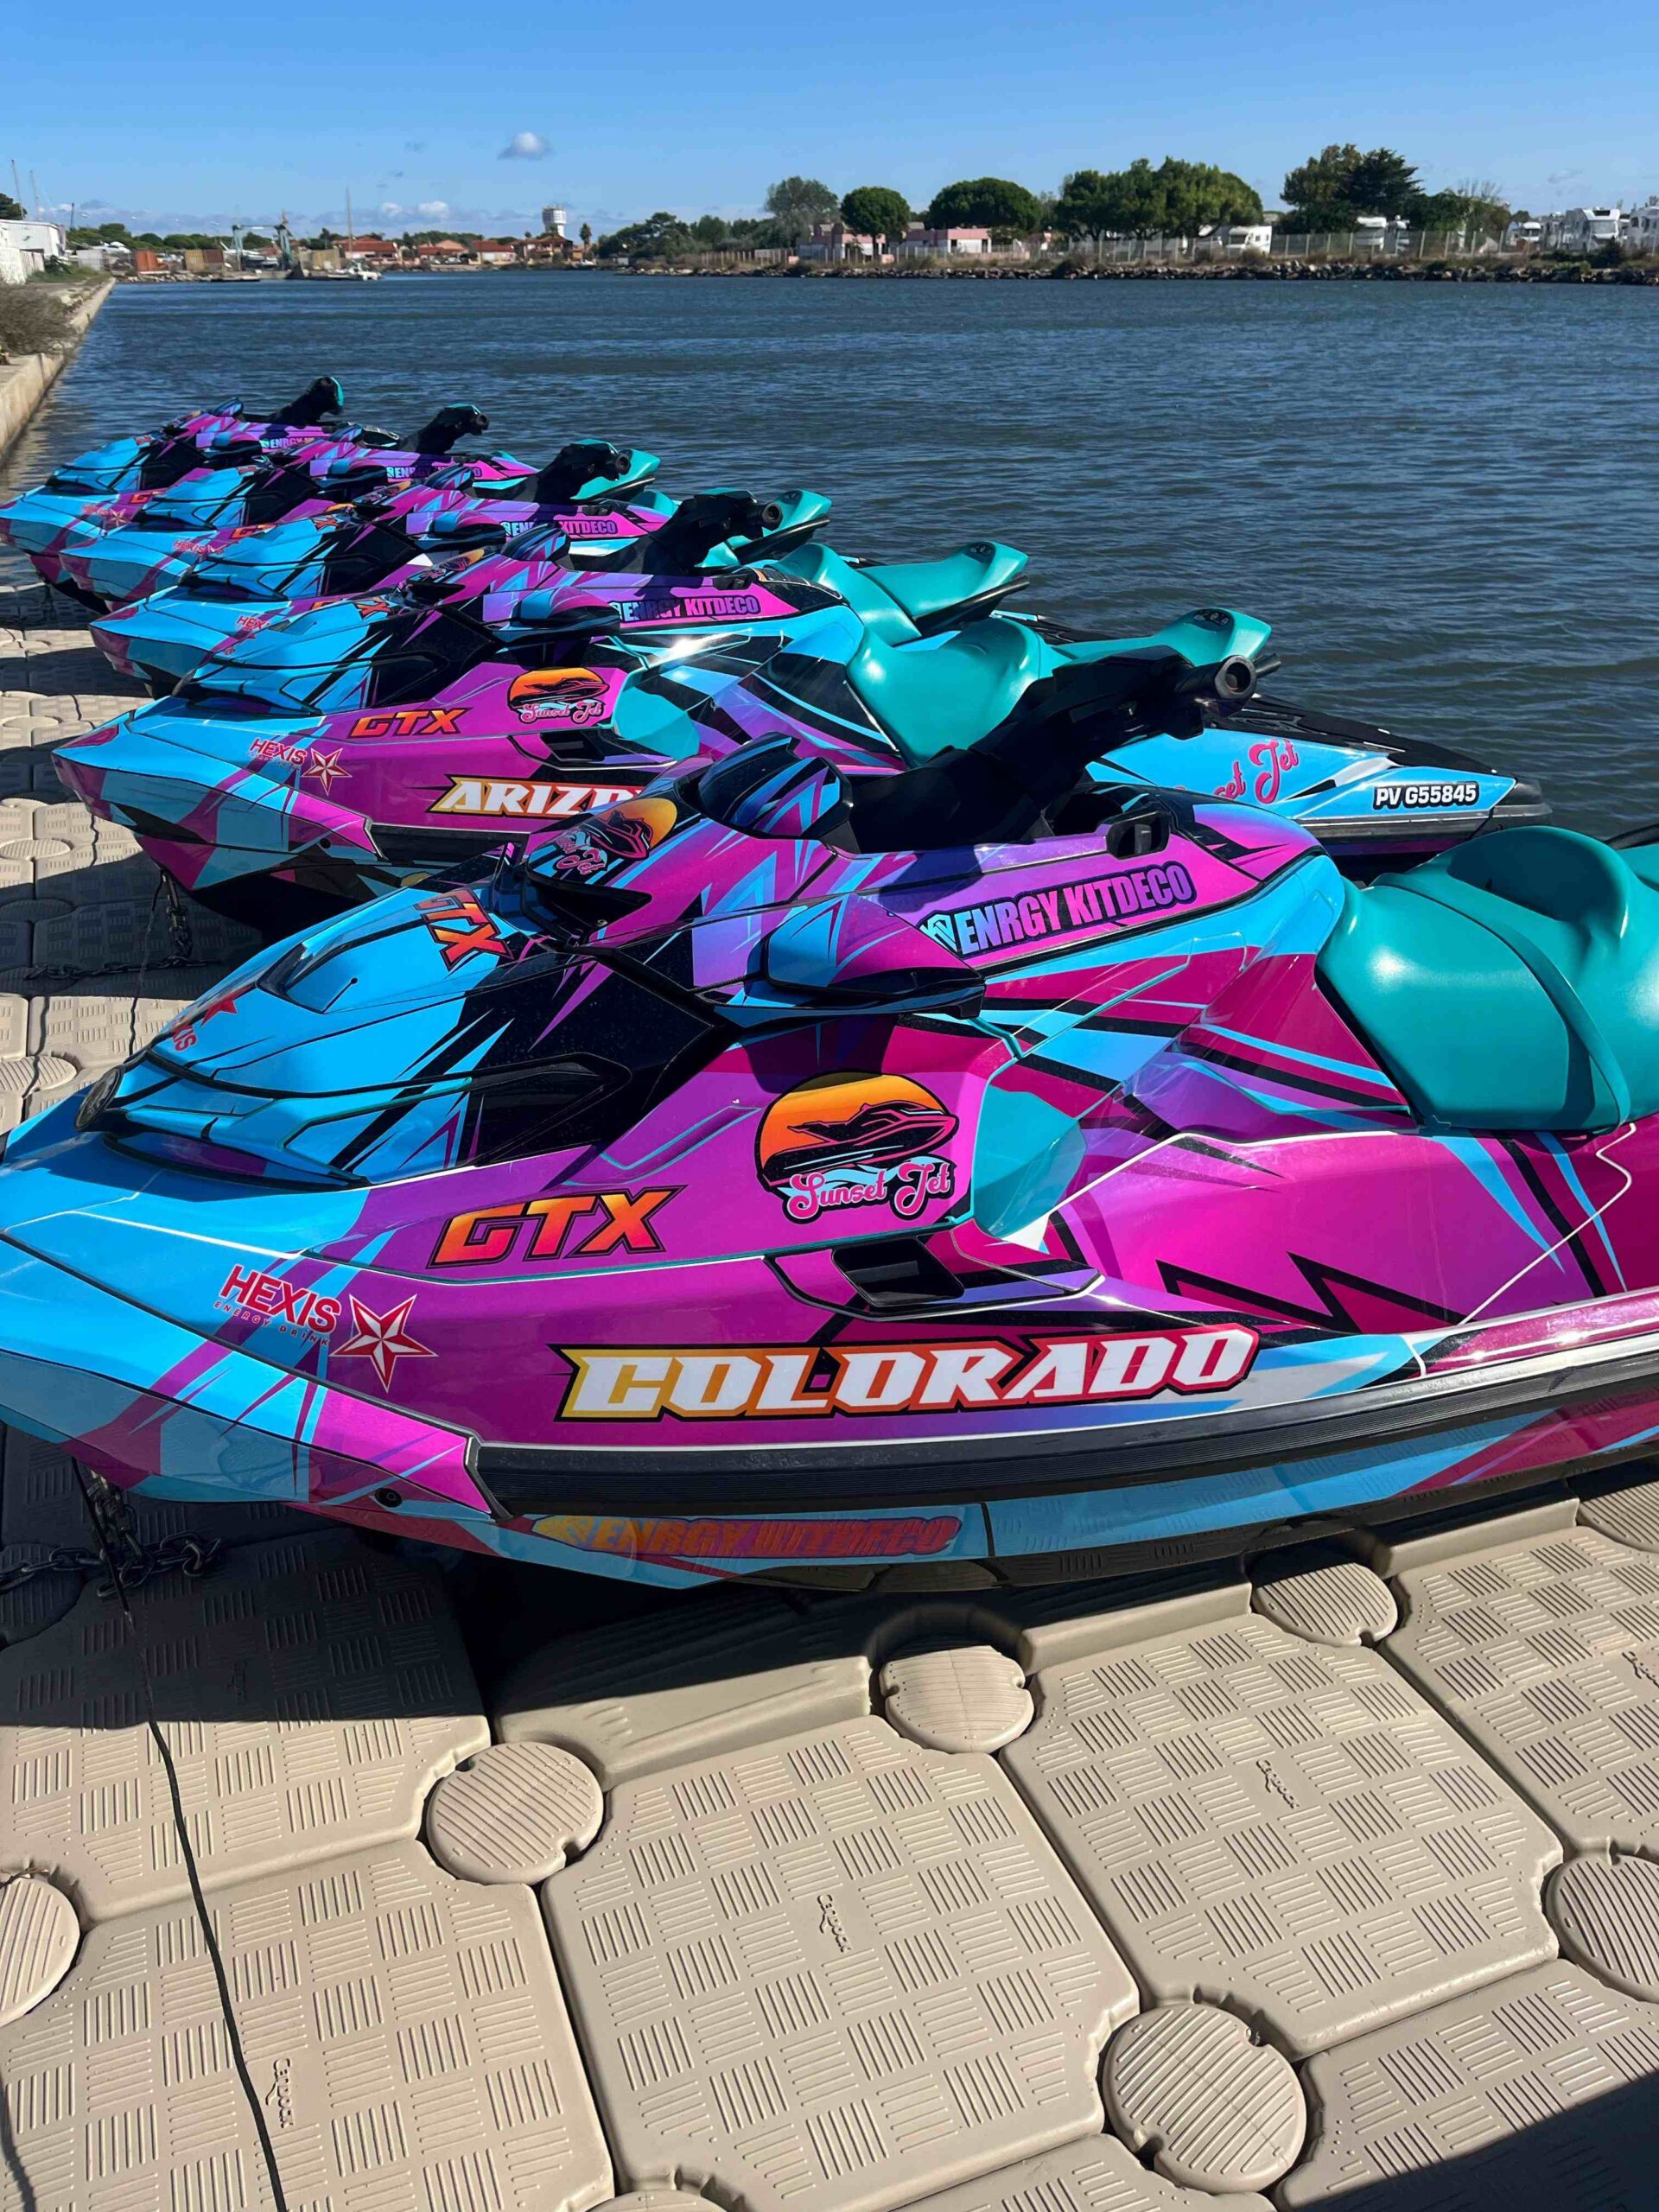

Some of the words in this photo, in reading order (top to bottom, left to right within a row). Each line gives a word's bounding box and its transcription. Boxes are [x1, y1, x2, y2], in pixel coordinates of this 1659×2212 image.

[236, 615, 270, 629] HEX
[684, 596, 760, 616] KITDECO
[347, 708, 471, 739] GTX
[520, 703, 570, 722] Sunset
[572, 701, 602, 722] Jet
[250, 738, 307, 765] HEXIS
[1249, 739, 1299, 804] Jet
[1376, 787, 1402, 806] PV
[1405, 785, 1477, 804] G55845
[954, 891, 1061, 955] ENRGY
[1063, 865, 1193, 926] KITDECO
[787, 1170, 887, 1219] Sunset
[894, 1162, 950, 1215] Jet
[429, 1188, 678, 1267] GTX
[219, 1263, 341, 1333] HEXIS
[214, 1301, 270, 1327] ENERGY
[279, 1325, 331, 1346] DRINK
[562, 1325, 1257, 1418] COLORADO
